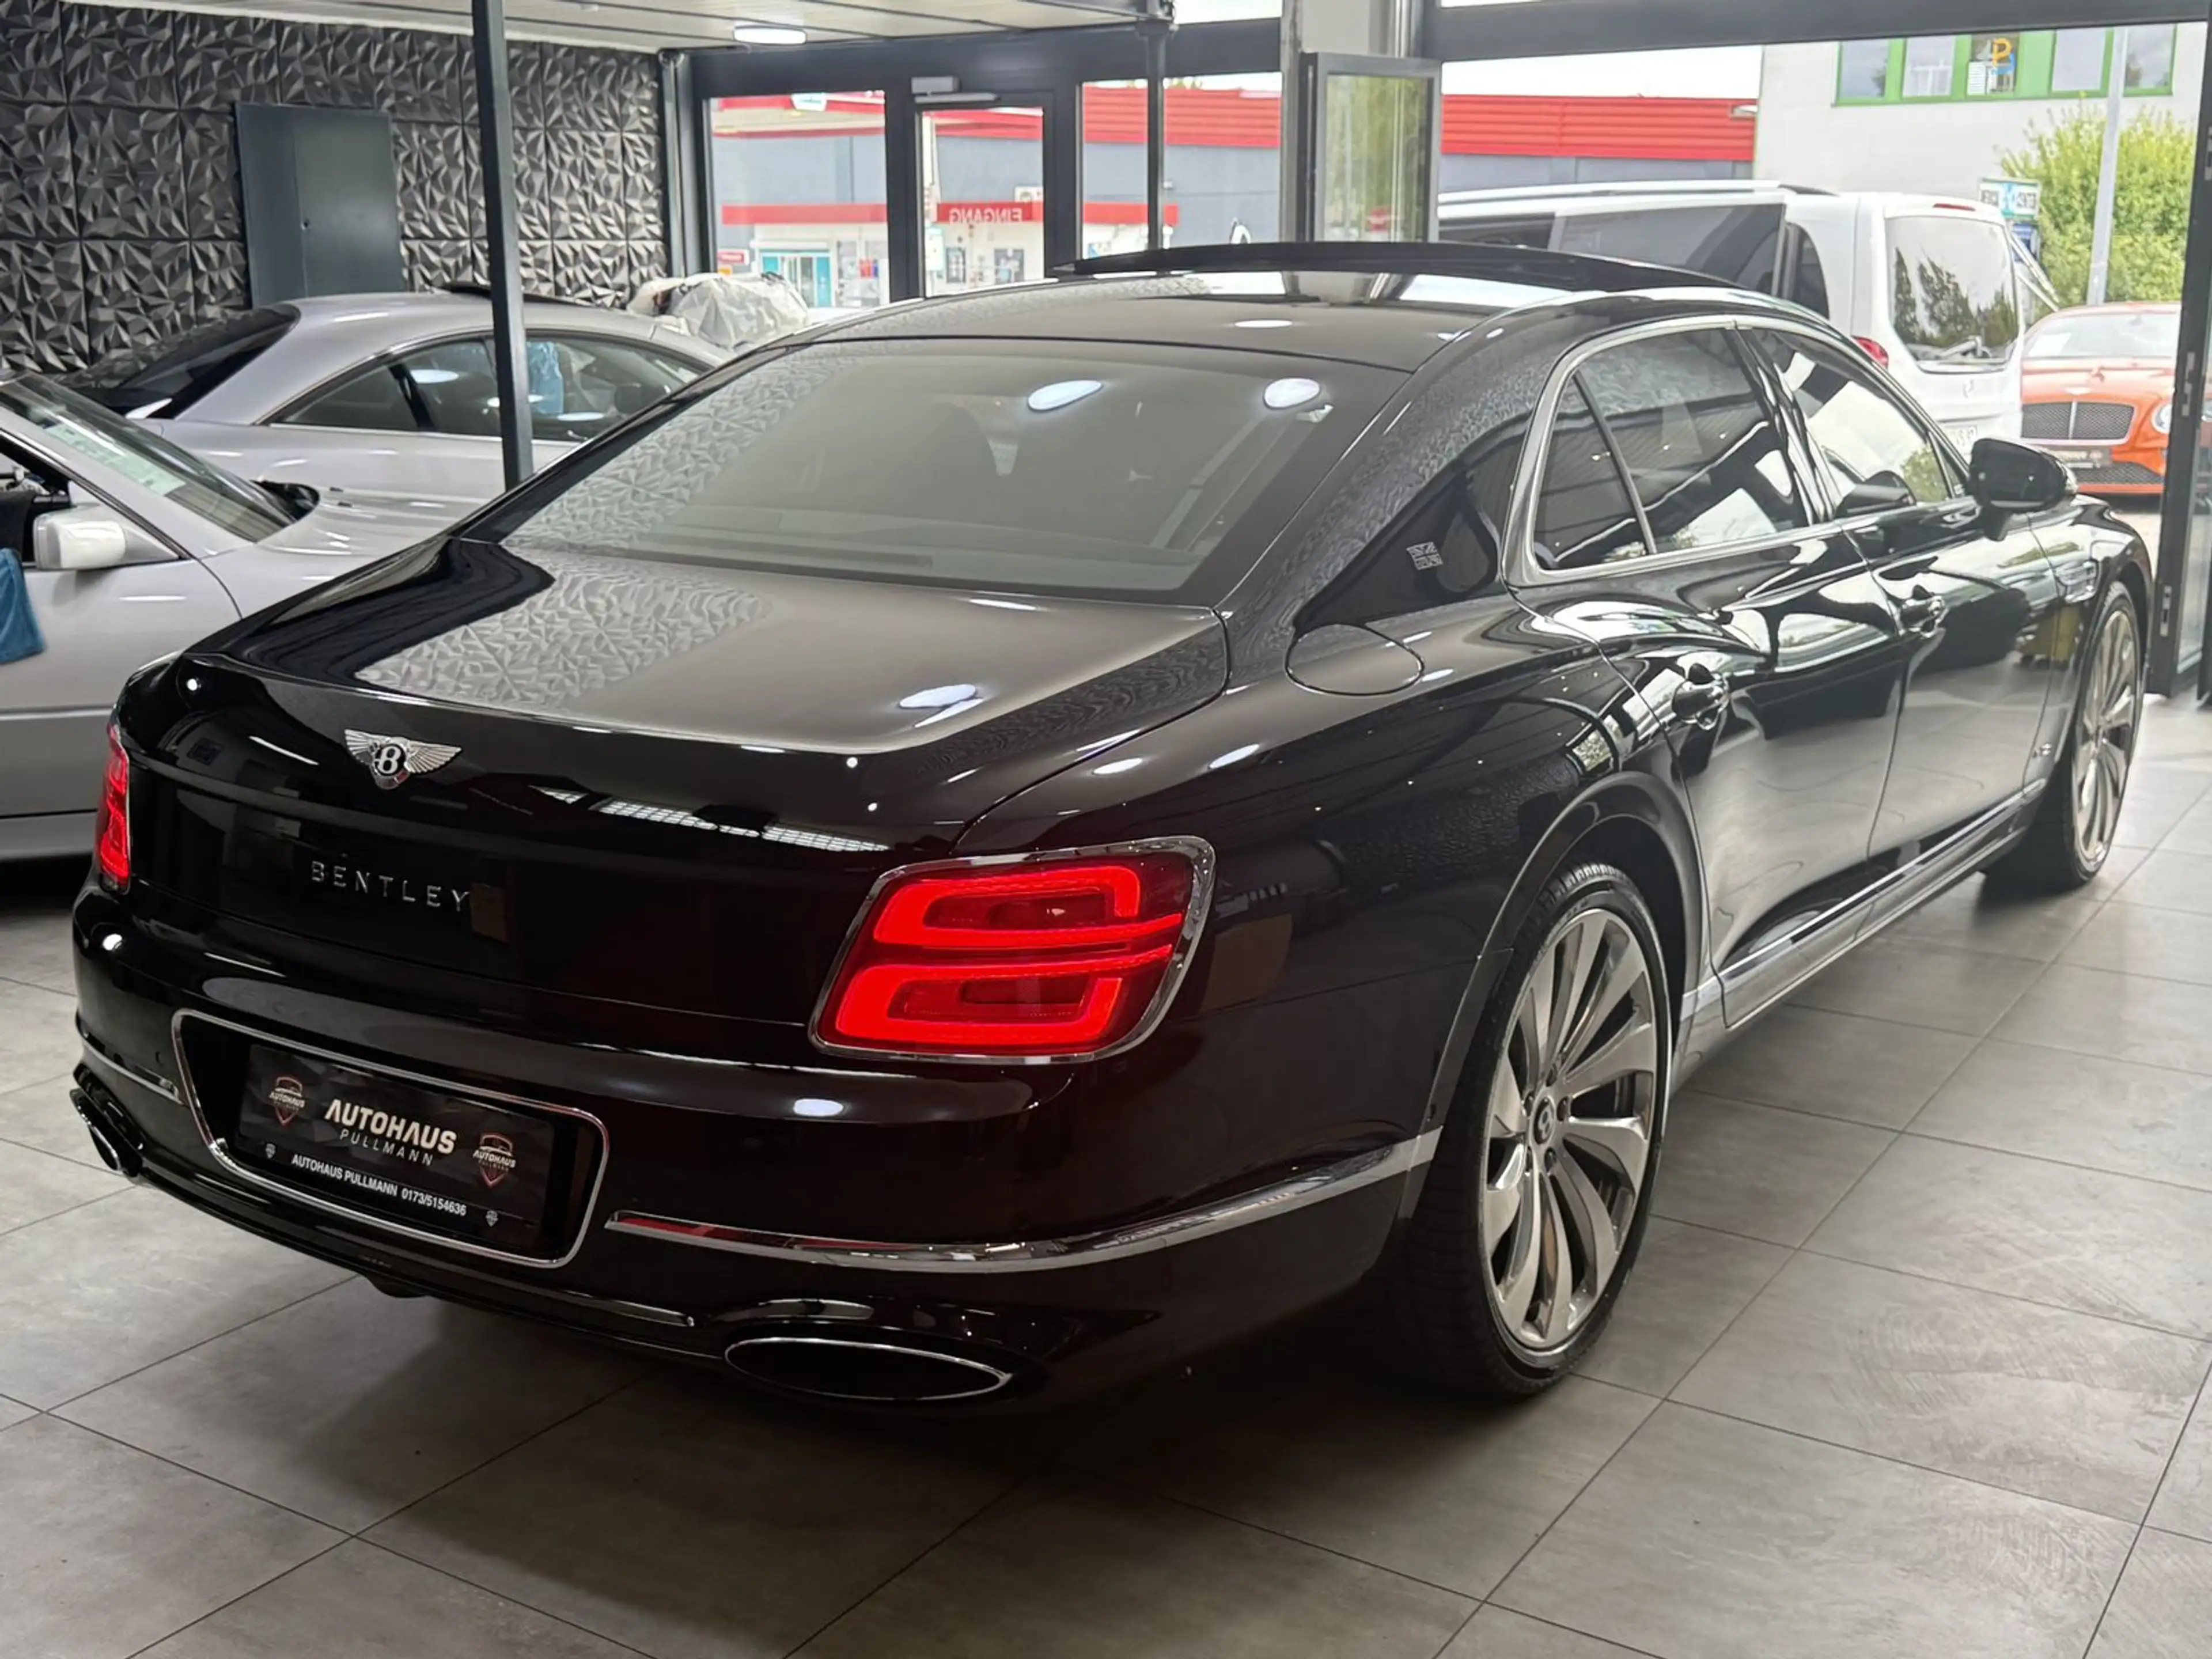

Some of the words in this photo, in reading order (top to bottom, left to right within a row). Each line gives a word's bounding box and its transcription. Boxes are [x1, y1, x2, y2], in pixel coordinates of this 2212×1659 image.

[312, 861, 469, 912] BENTLEY
[324, 1099, 457, 1154] AUTOHAUS
[339, 1128, 434, 1166] PULLMANN
[472, 1149, 516, 1169] AUTOHAUS
[291, 1153, 343, 1180] AUTOHAUS
[344, 1169, 397, 1197] PULLMANN
[401, 1187, 467, 1217] 0173/5154636
